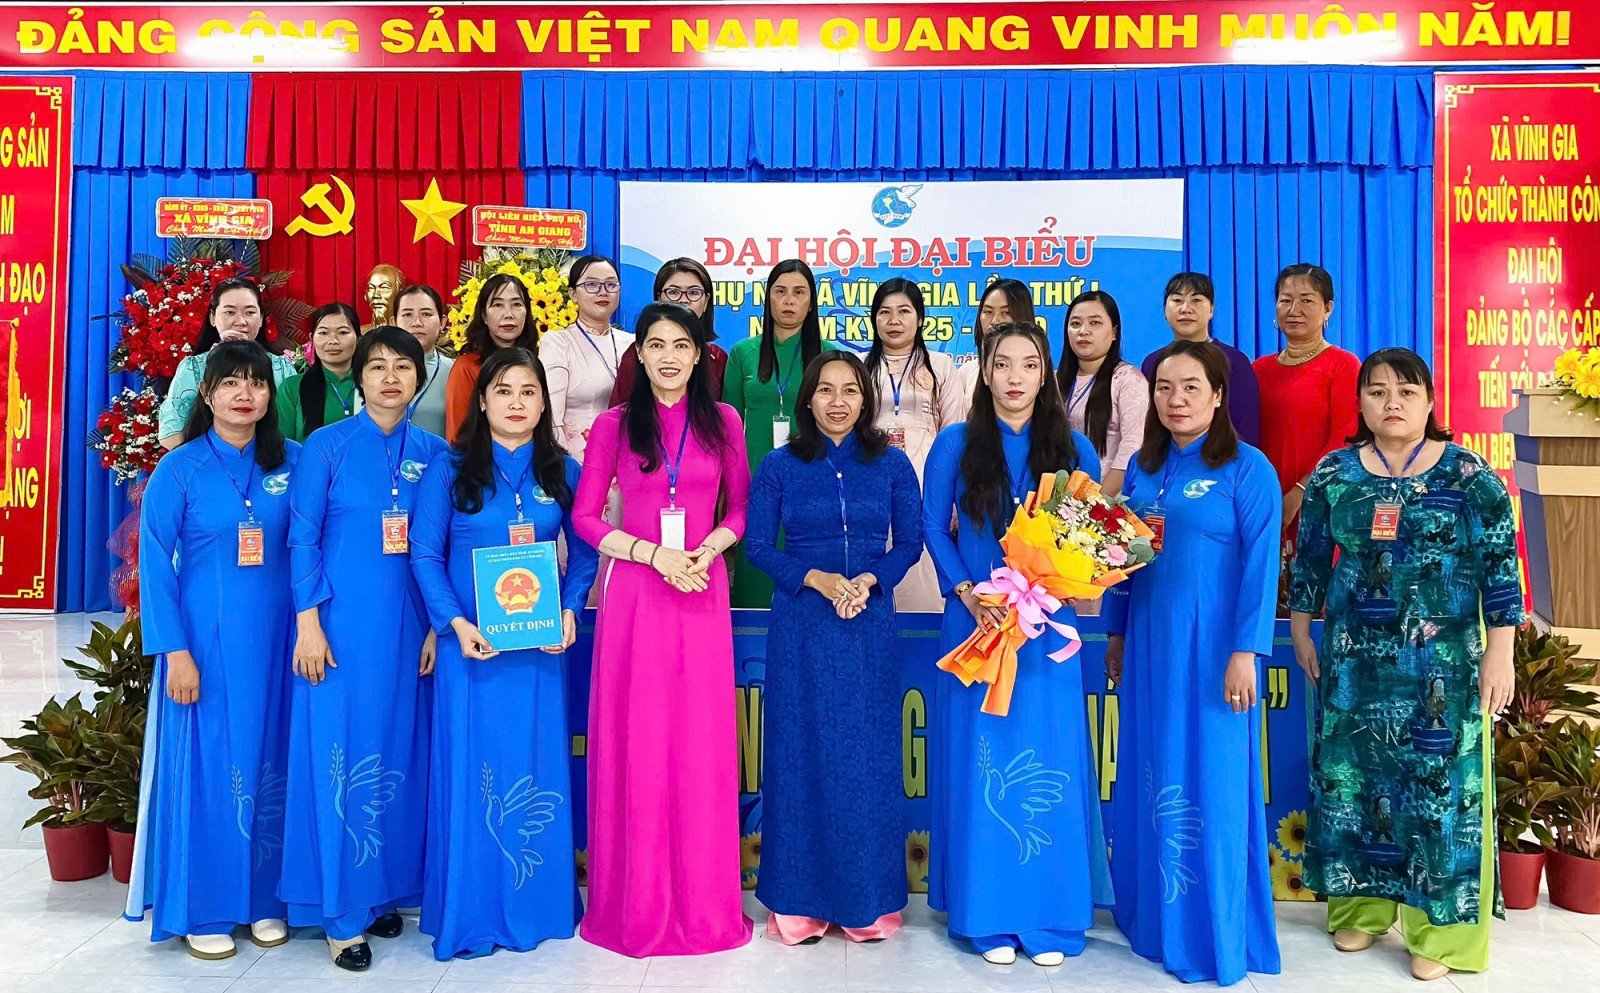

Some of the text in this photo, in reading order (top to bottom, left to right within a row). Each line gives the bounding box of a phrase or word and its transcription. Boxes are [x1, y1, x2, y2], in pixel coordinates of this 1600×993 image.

[16, 8, 177, 54] ĐẢNG
[380, 6, 496, 54] SẢN
[516, 11, 651, 63] VIỆT
[671, 18, 799, 53] NAM
[819, 15, 1030, 52] QUANG
[1052, 14, 1198, 50] VINH
[1419, 1, 1570, 46] NĂM!
[17, 111, 49, 168] SẢN
[1552, 124, 1579, 161] GIA
[231, 215, 254, 225] GIA
[480, 211, 496, 219] HỘI
[499, 212, 520, 220] LIÊN
[1454, 165, 1474, 223] TỔ
[1476, 175, 1518, 223] CHỨC
[1520, 174, 1568, 222] THÀNH
[489, 221, 571, 236] TỈNH AN GIANG
[704, 216, 1096, 276] ĐẠI HỘI ĐẠI BIỂU
[10, 262, 46, 316] ĐẠO
[1508, 236, 1562, 296] ĐẠI HỘI
[712, 281, 745, 312] HỤ
[1466, 295, 1509, 347] ĐẢNG
[1512, 299, 1533, 357] BỘ
[1535, 298, 1569, 347] CÁC
[1478, 354, 1507, 408] TIẾN
[486, 619, 555, 636] QUYẾT ĐỊNH
